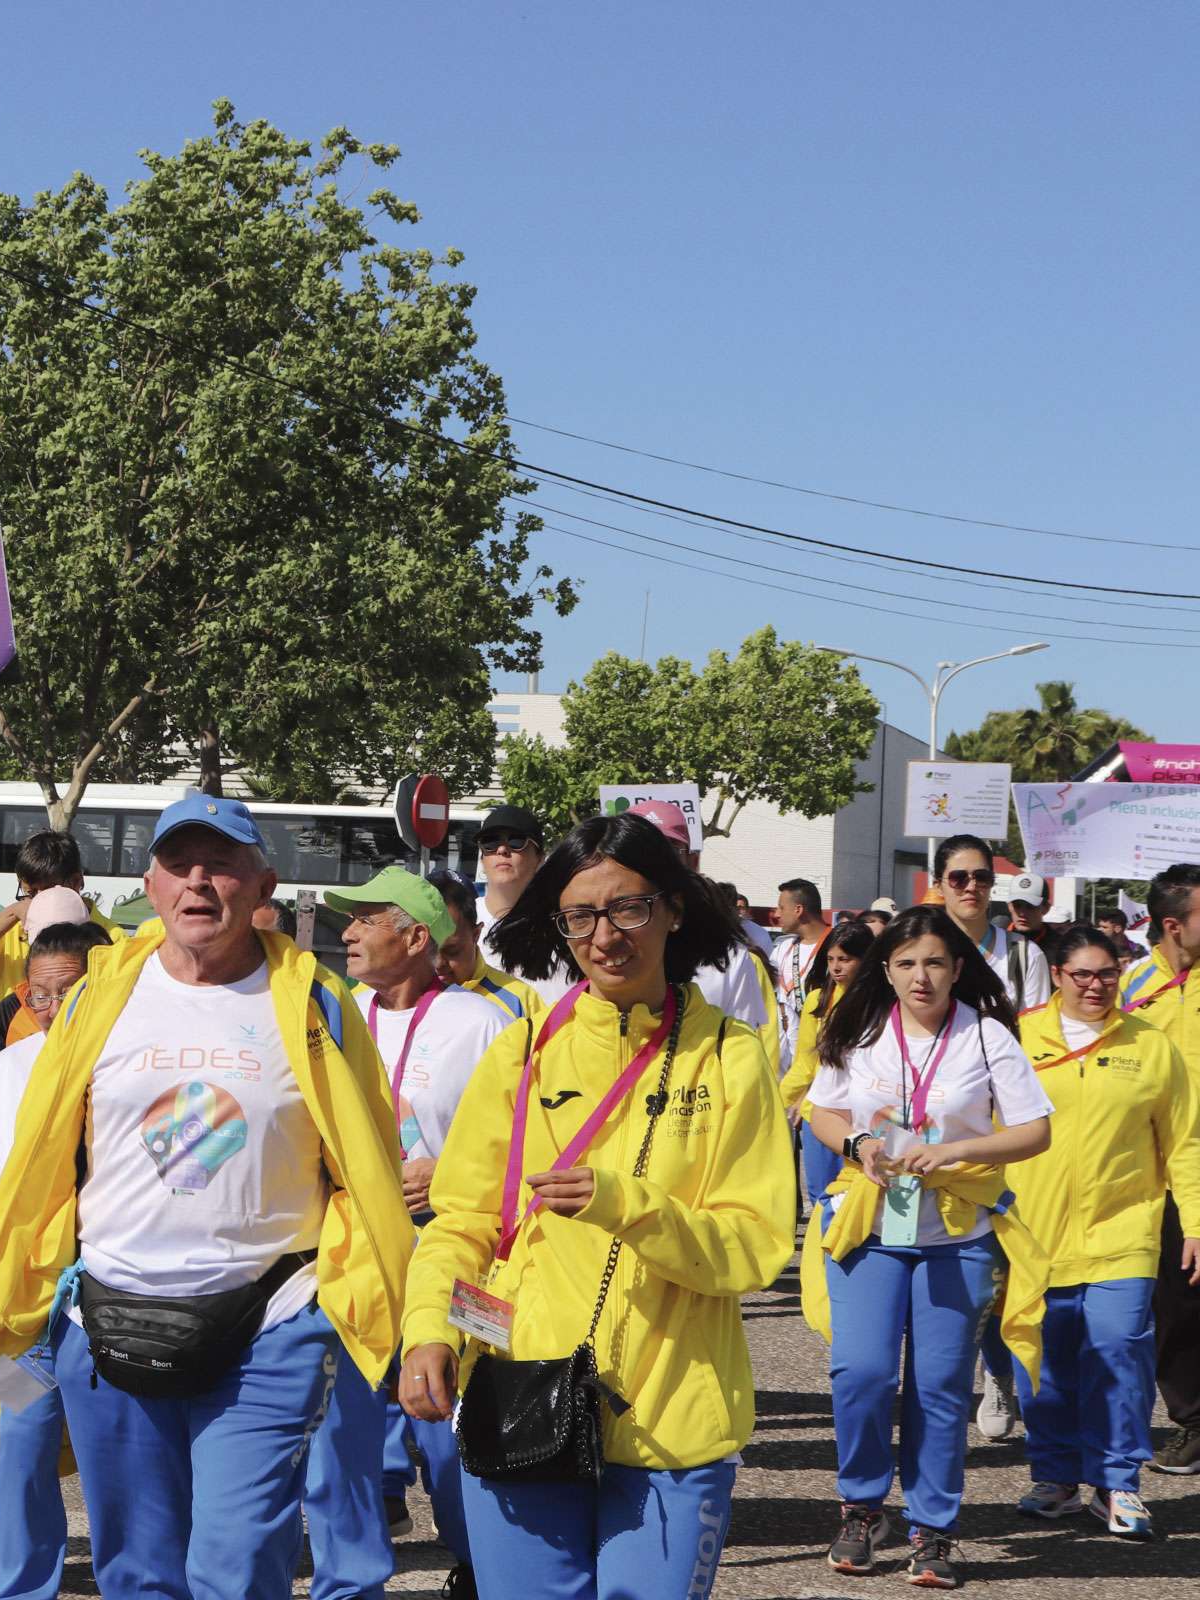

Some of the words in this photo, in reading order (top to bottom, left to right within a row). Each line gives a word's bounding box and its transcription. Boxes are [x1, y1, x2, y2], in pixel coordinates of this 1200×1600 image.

[1109, 800, 1146, 815] Plena
[134, 1046, 262, 1073] JEDES
[224, 1072, 261, 1082] 2023
[109, 1348, 129, 1360] Sport
[151, 1359, 172, 1369] Sport
